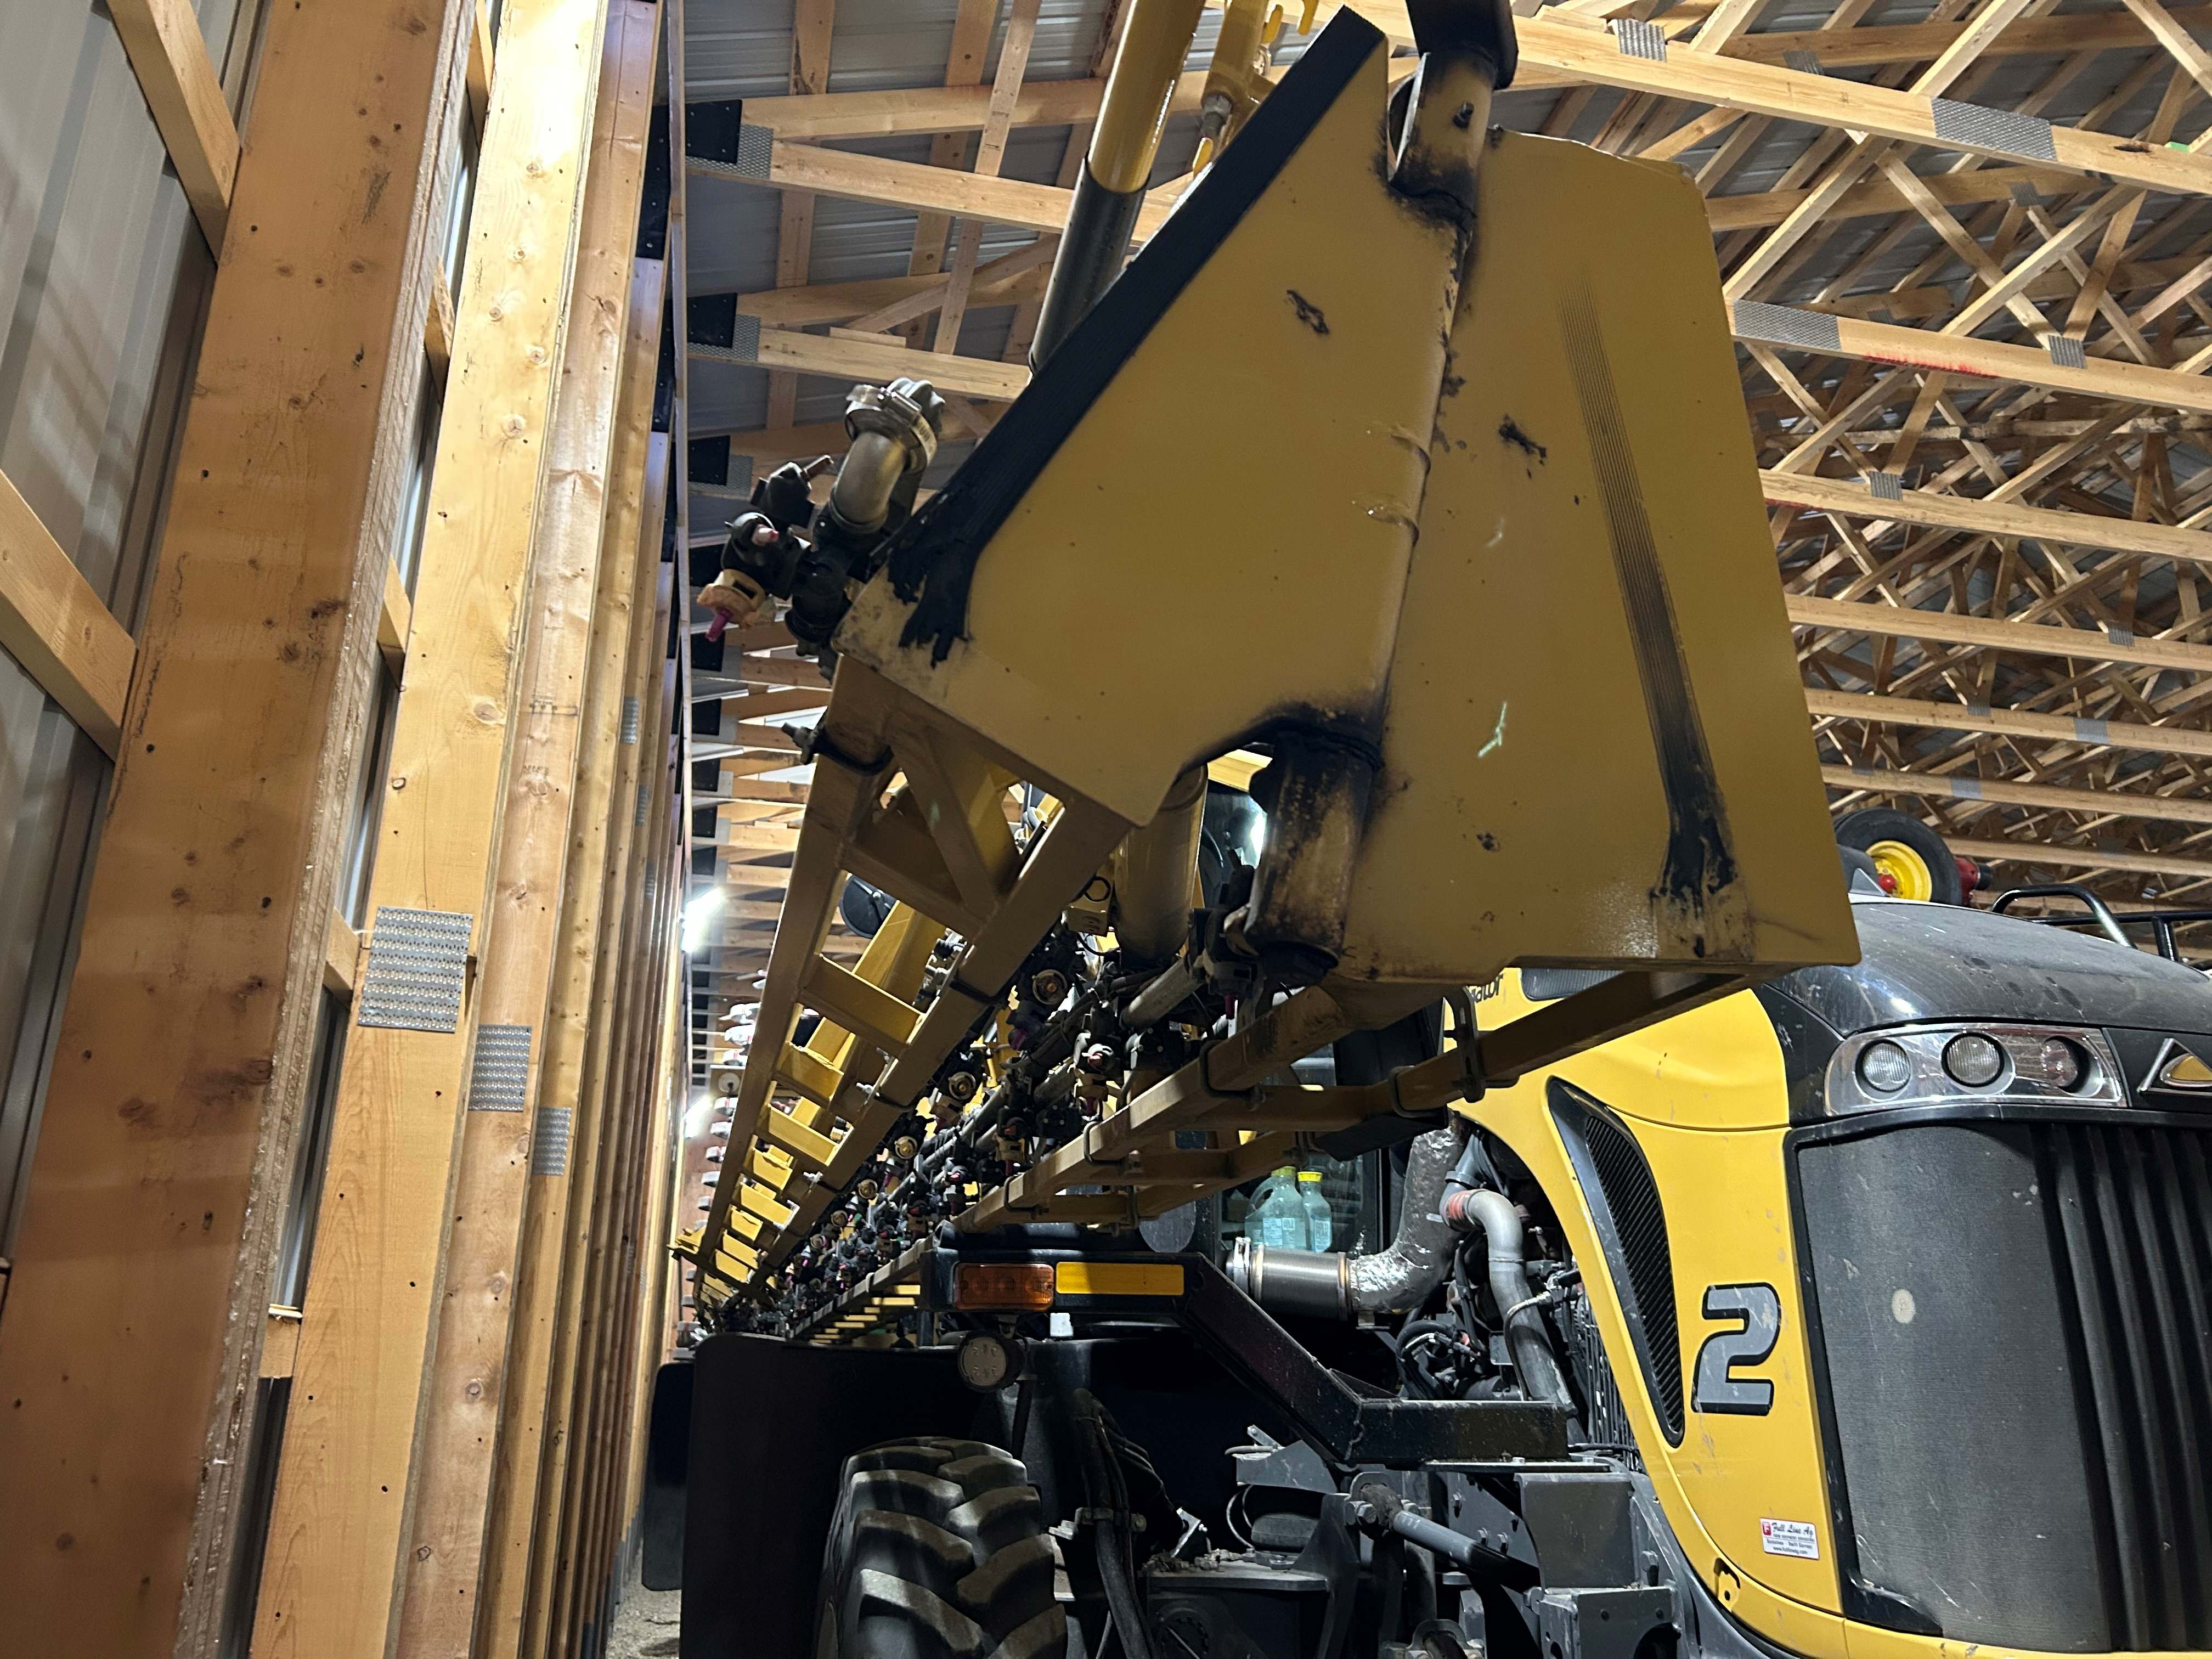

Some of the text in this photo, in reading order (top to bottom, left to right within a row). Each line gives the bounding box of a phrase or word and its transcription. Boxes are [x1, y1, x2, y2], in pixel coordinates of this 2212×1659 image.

[1691, 1282, 1782, 1417] 2
[1771, 1522, 1785, 1532] Full
[1787, 1523, 1802, 1534] Line
[1803, 1526, 1813, 1538] Ag
